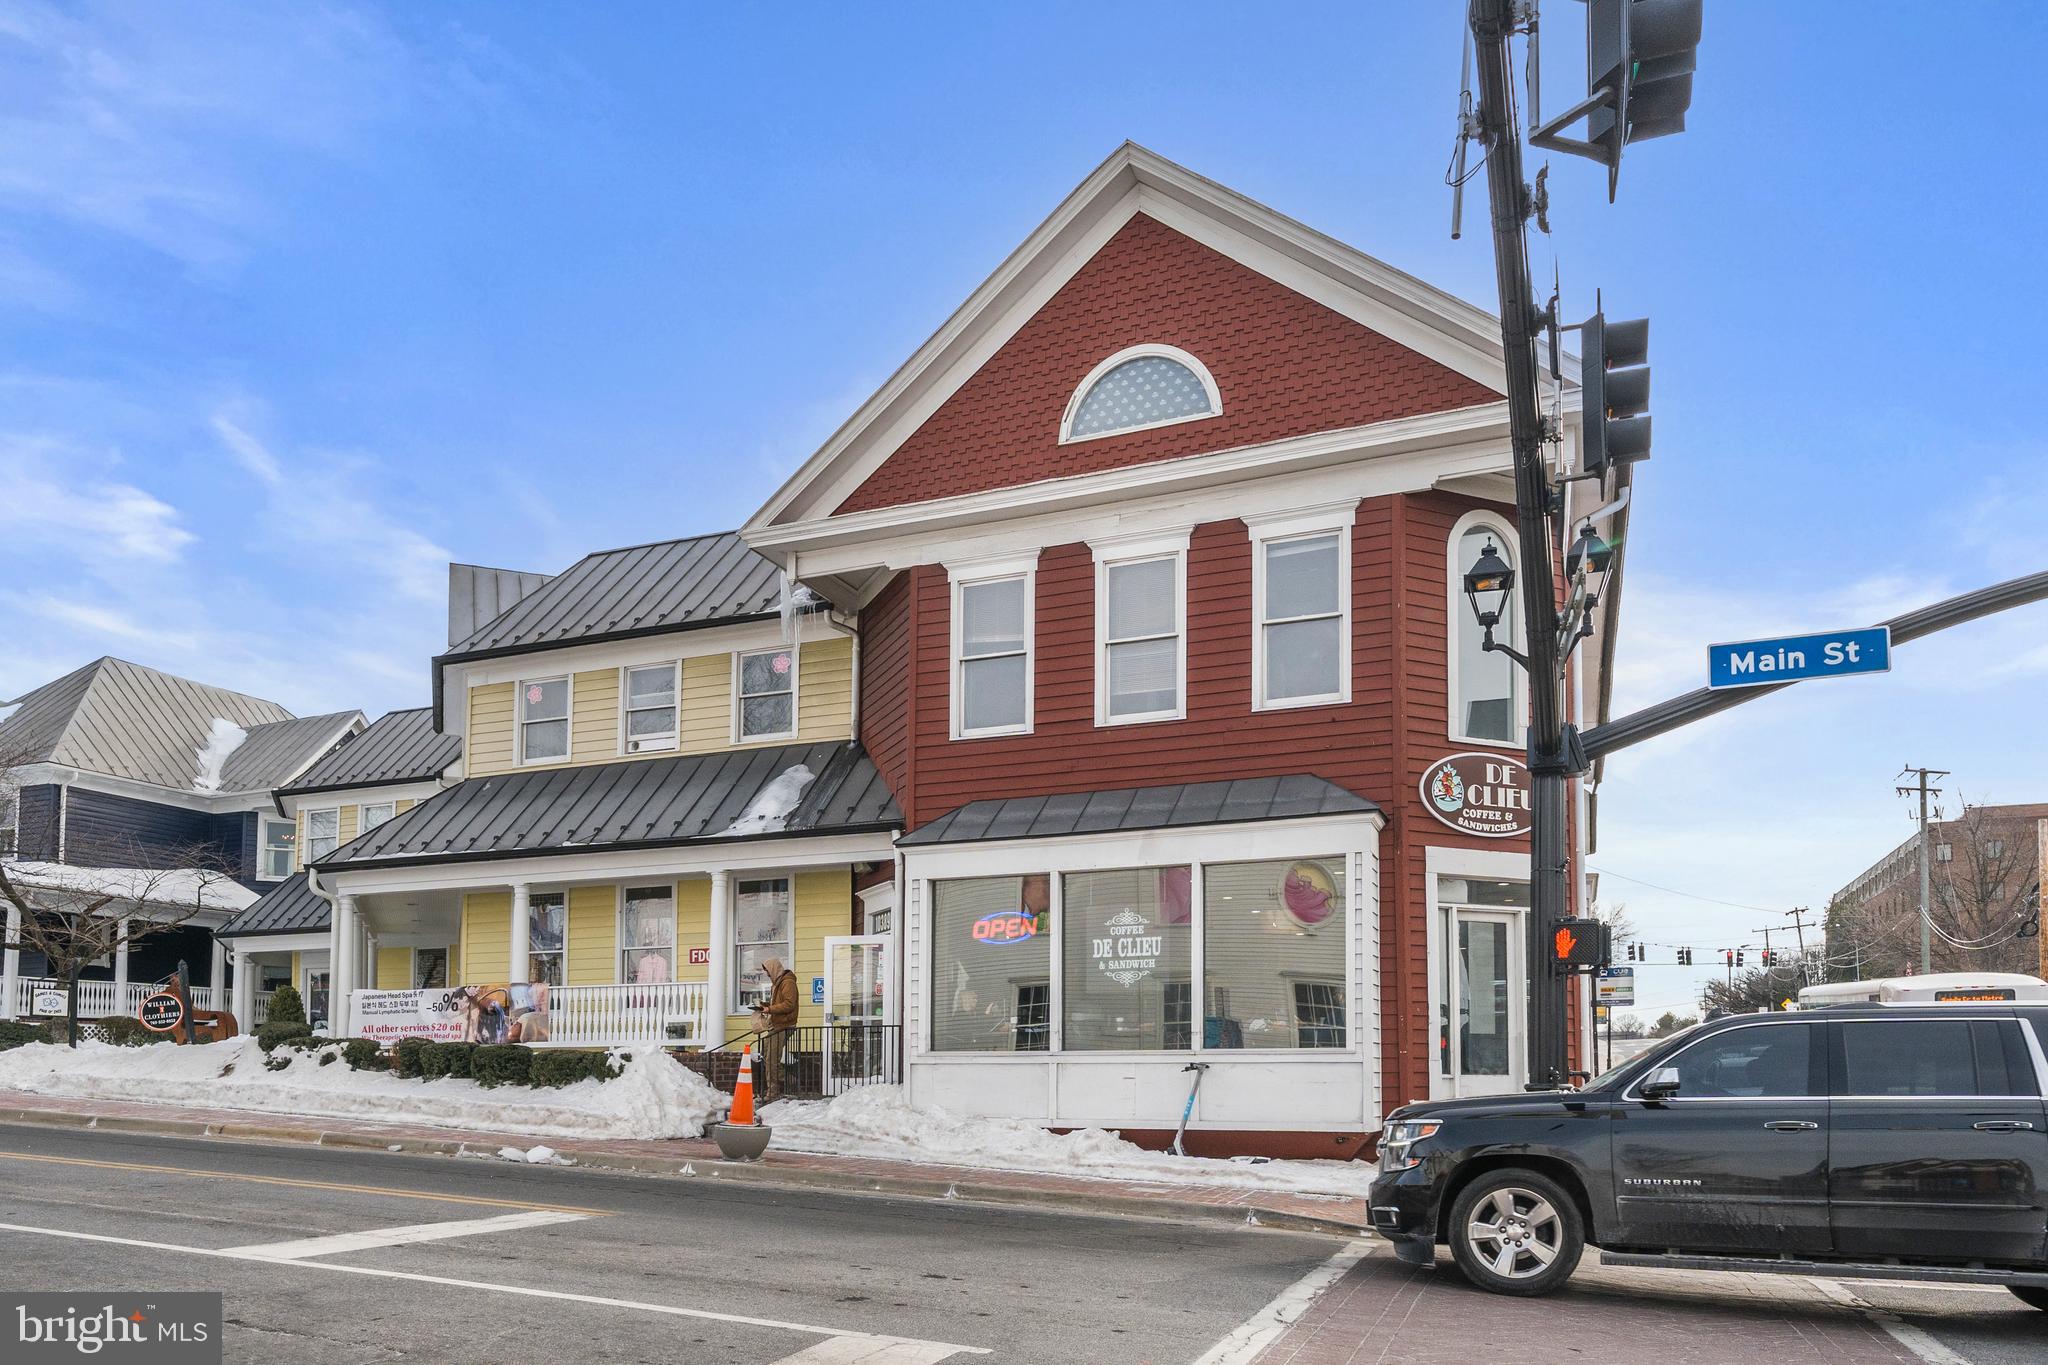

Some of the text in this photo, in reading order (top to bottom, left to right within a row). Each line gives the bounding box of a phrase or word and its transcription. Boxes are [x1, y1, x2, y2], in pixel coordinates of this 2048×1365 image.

[1730, 640, 1860, 676] Main St
[1485, 763, 1518, 786] DE
[1462, 808, 1514, 821] COFFEE &
[1457, 817, 1518, 833] SANDWICHES
[972, 916, 1039, 940] OPEN
[1110, 925, 1145, 936] COFFEE
[1092, 936, 1162, 958] DE CLIEU
[1098, 959, 1156, 970] & SANDWICH
[362, 993, 387, 1001] Japanese
[401, 991, 413, 1000] Spa
[147, 1000, 176, 1008] WILLIAM
[144, 1011, 180, 1020] CLOTHIERS
[362, 1022, 462, 1034] All other services $20 off
[1623, 1178, 1702, 1187] SUBURBAN
